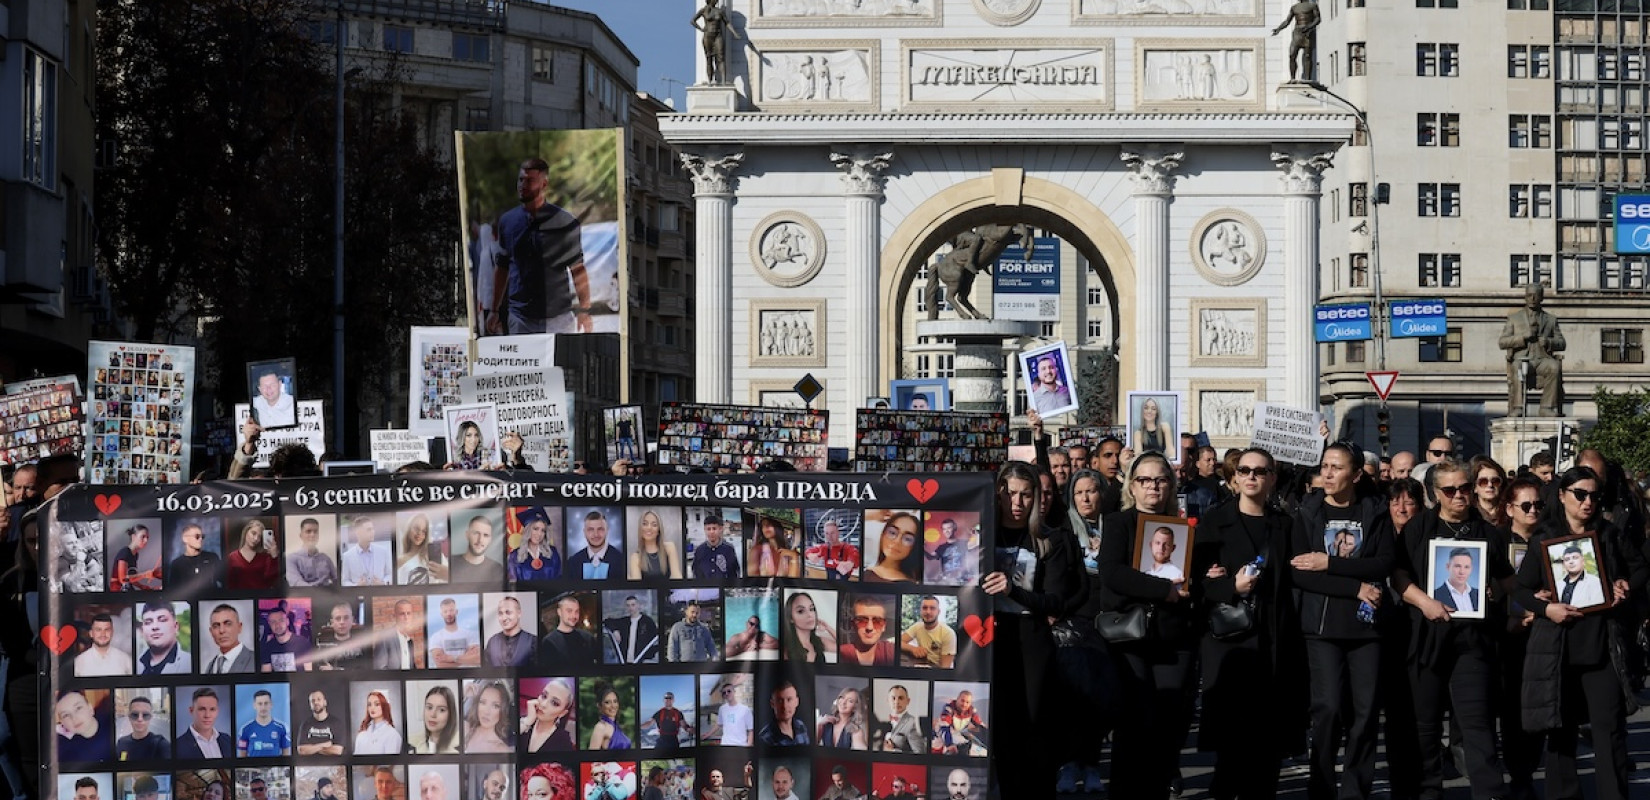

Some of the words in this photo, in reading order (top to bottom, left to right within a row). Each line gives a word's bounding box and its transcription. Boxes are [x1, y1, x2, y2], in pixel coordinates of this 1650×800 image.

[920, 65, 1098, 86] МАКЕДОНИЈА
[1000, 263, 1023, 273] FOR
[1025, 263, 1055, 273] RENT
[1316, 307, 1368, 320] setec
[1392, 303, 1443, 316] setec
[1327, 324, 1362, 338] Midea
[1402, 320, 1437, 334] Midea
[499, 344, 518, 353] НИЕ
[478, 357, 540, 367] РОДИТЕЛИТЕ
[476, 376, 496, 390] КРИВ
[498, 376, 503, 389] Е
[303, 406, 316, 418] ДА
[498, 403, 559, 422] ЕОДГОВОРНОСТ.
[543, 420, 565, 437] ДЕЦА
[157, 491, 273, 513] 16.03.2025
[295, 486, 320, 510] 63
[324, 486, 392, 506] сенки
[397, 480, 423, 503] ќе
[429, 484, 454, 501] ве
[460, 482, 537, 502] следат
[560, 478, 622, 502] секој
[628, 482, 708, 502] поглед
[714, 479, 769, 503] бара
[776, 481, 877, 504] ПРАВДА
